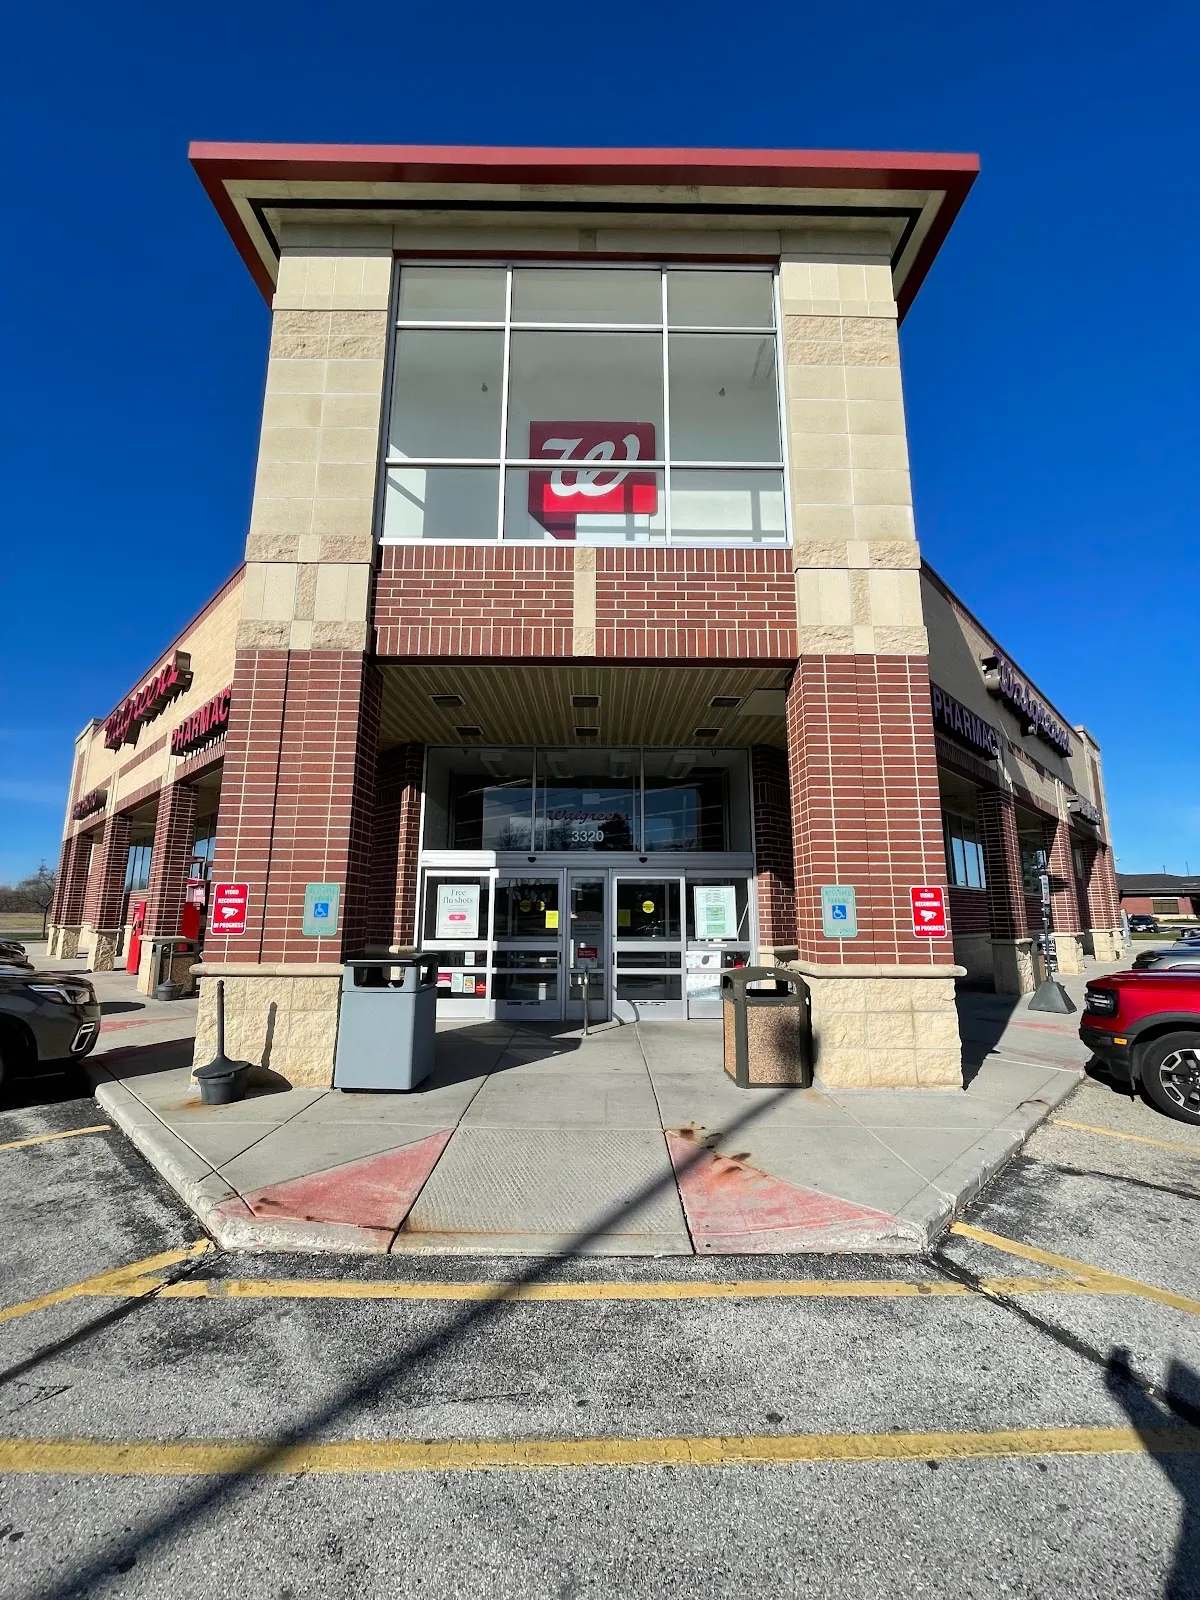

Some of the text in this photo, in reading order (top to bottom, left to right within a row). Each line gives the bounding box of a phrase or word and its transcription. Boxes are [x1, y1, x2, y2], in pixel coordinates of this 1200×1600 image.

[541, 433, 641, 497] W
[171, 687, 231, 752] PHARMAC
[571, 830, 605, 842] 3320
